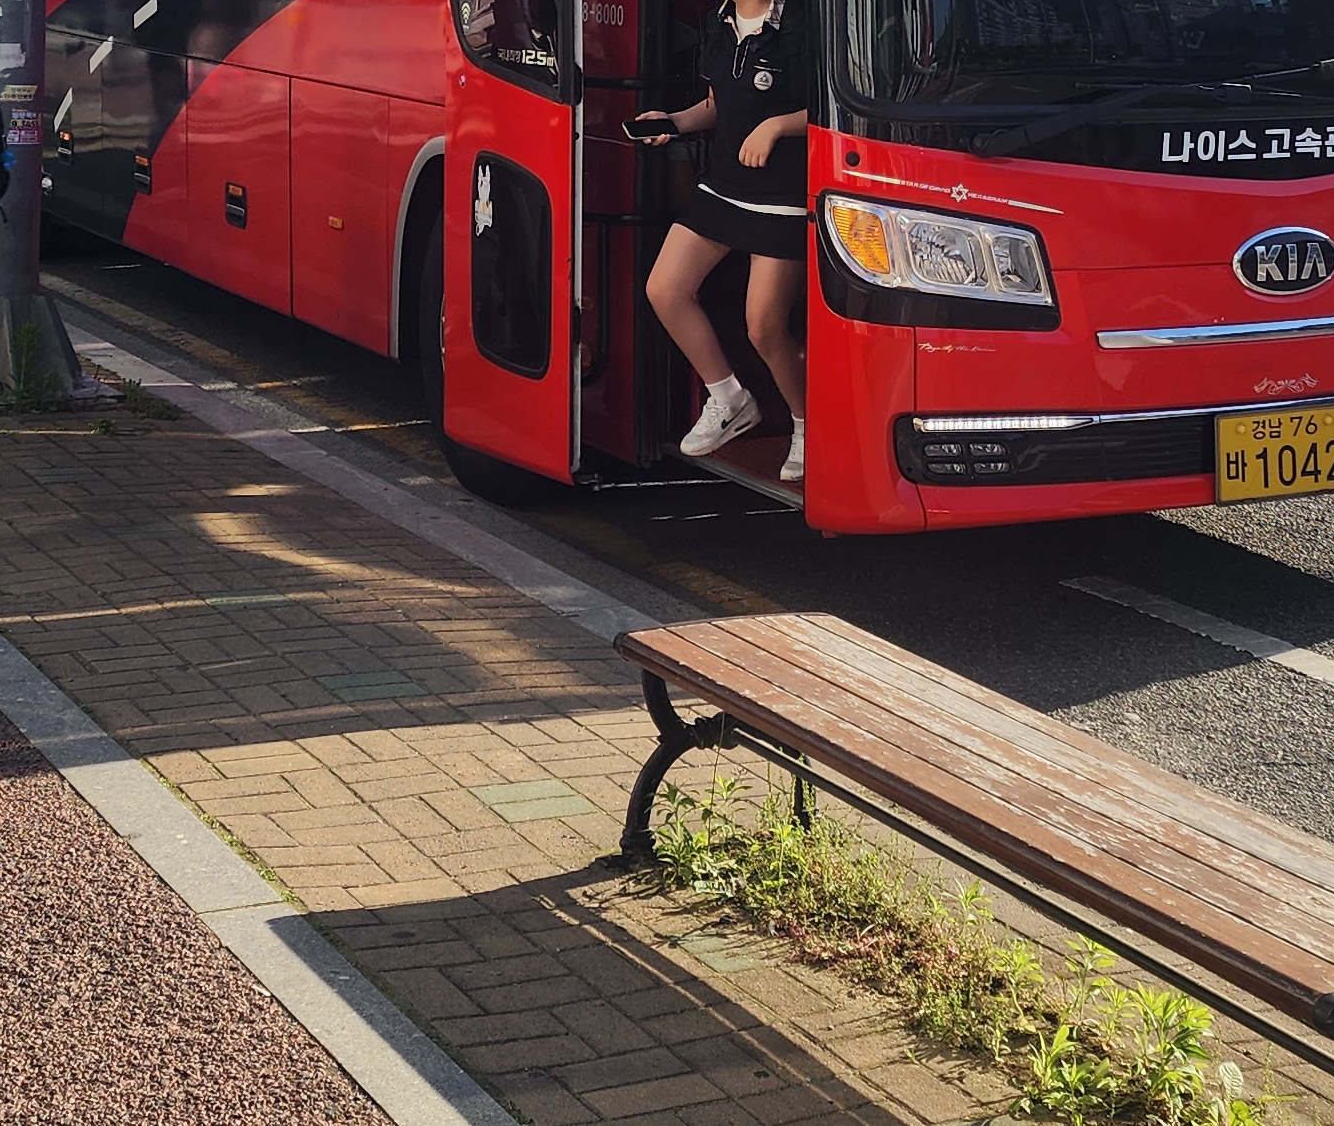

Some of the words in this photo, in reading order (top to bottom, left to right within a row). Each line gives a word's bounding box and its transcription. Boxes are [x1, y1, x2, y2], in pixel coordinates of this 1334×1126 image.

[1254, 242, 1327, 282] KIA
[1251, 417, 1283, 441] 경남
[1289, 414, 1318, 437] 76
[1225, 449, 1248, 483] 바
